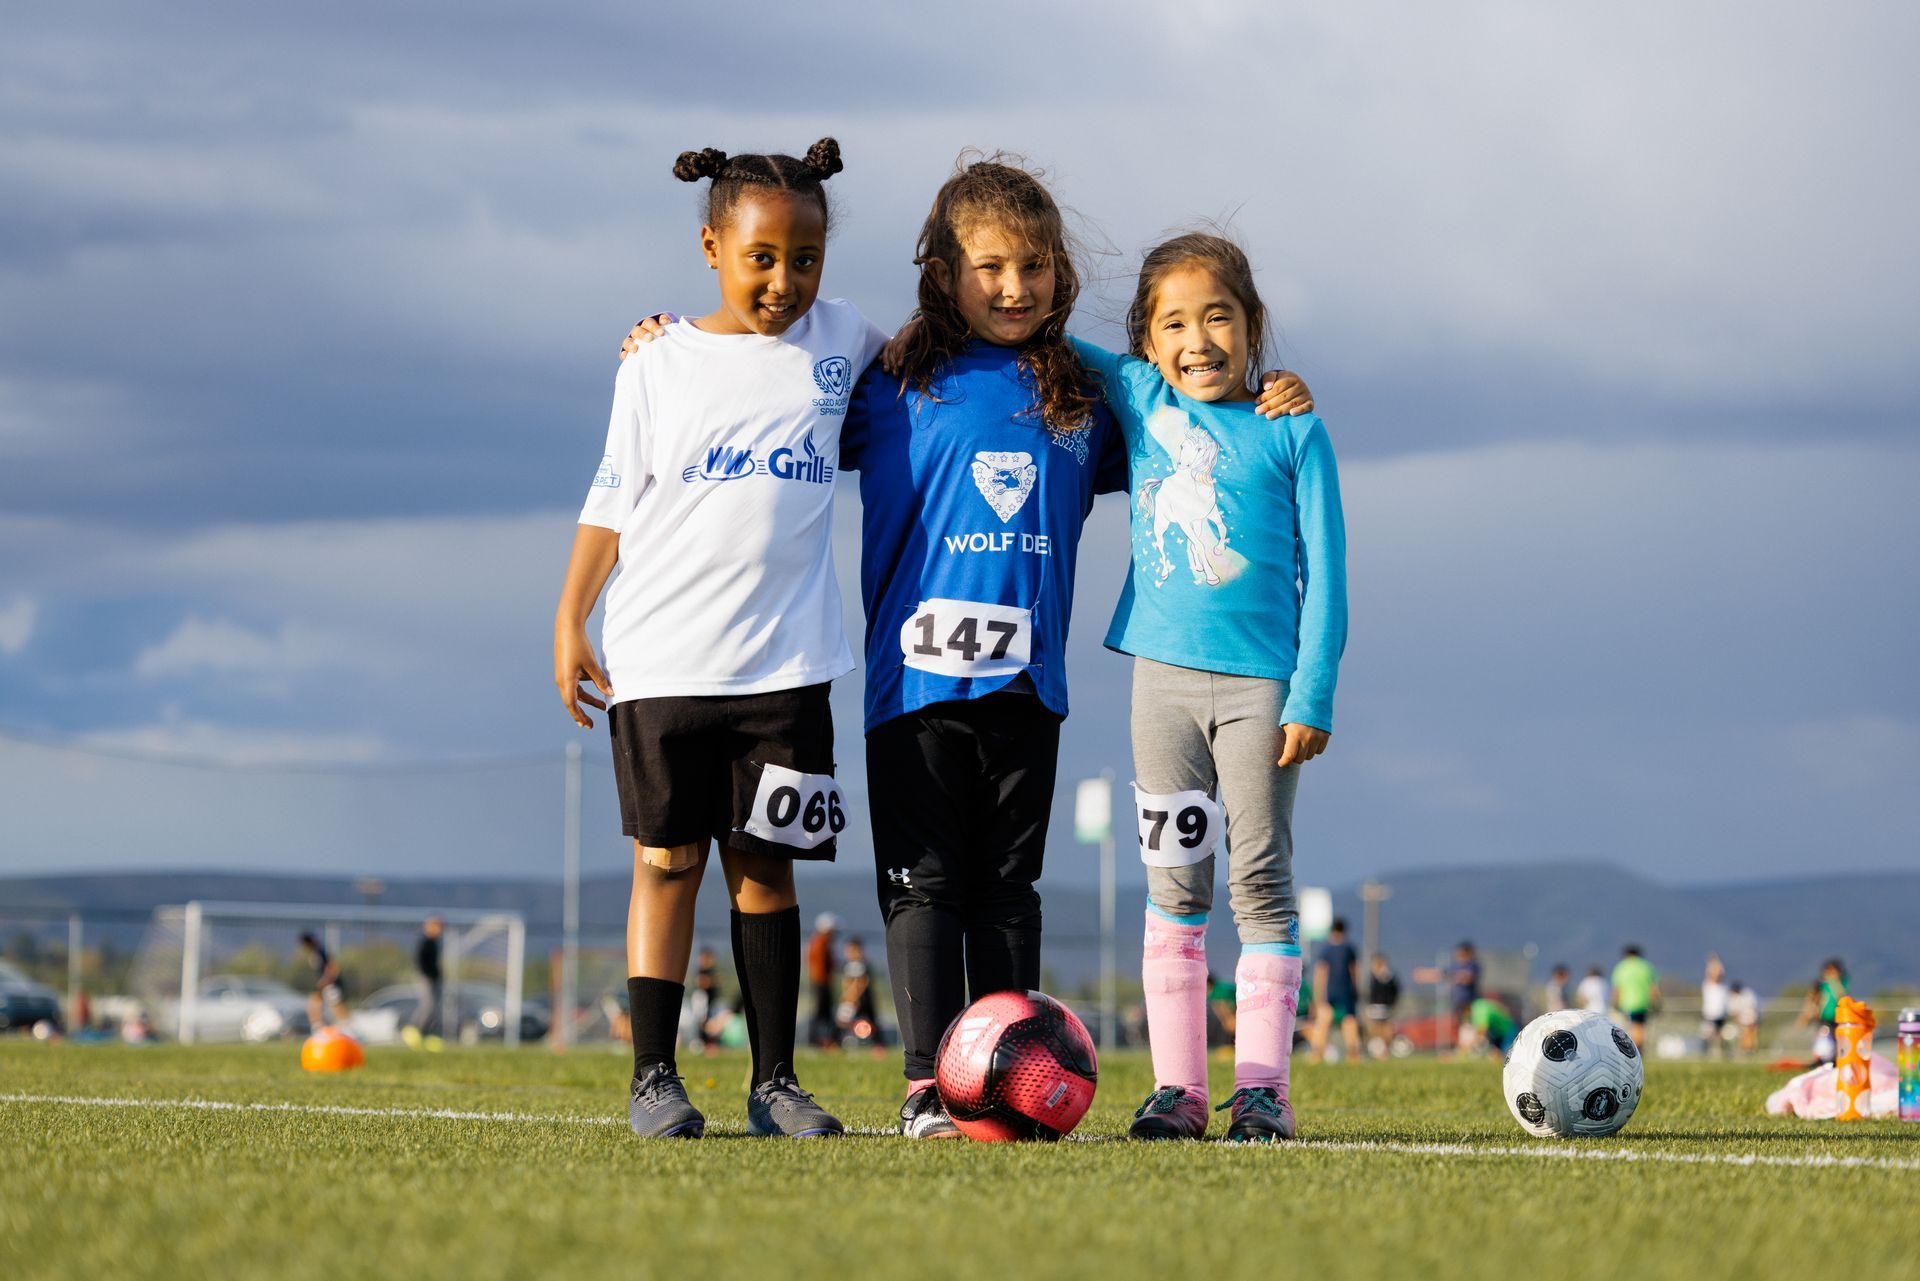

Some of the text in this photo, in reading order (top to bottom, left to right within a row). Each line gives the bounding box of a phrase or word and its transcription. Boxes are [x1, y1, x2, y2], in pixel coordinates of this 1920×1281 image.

[811, 398, 835, 407] SOZO
[768, 446, 825, 484] Grill
[943, 532, 1016, 555] WOLF
[913, 613, 1018, 662] 147
[766, 785, 846, 834] 066
[1136, 803, 1208, 851] 79
